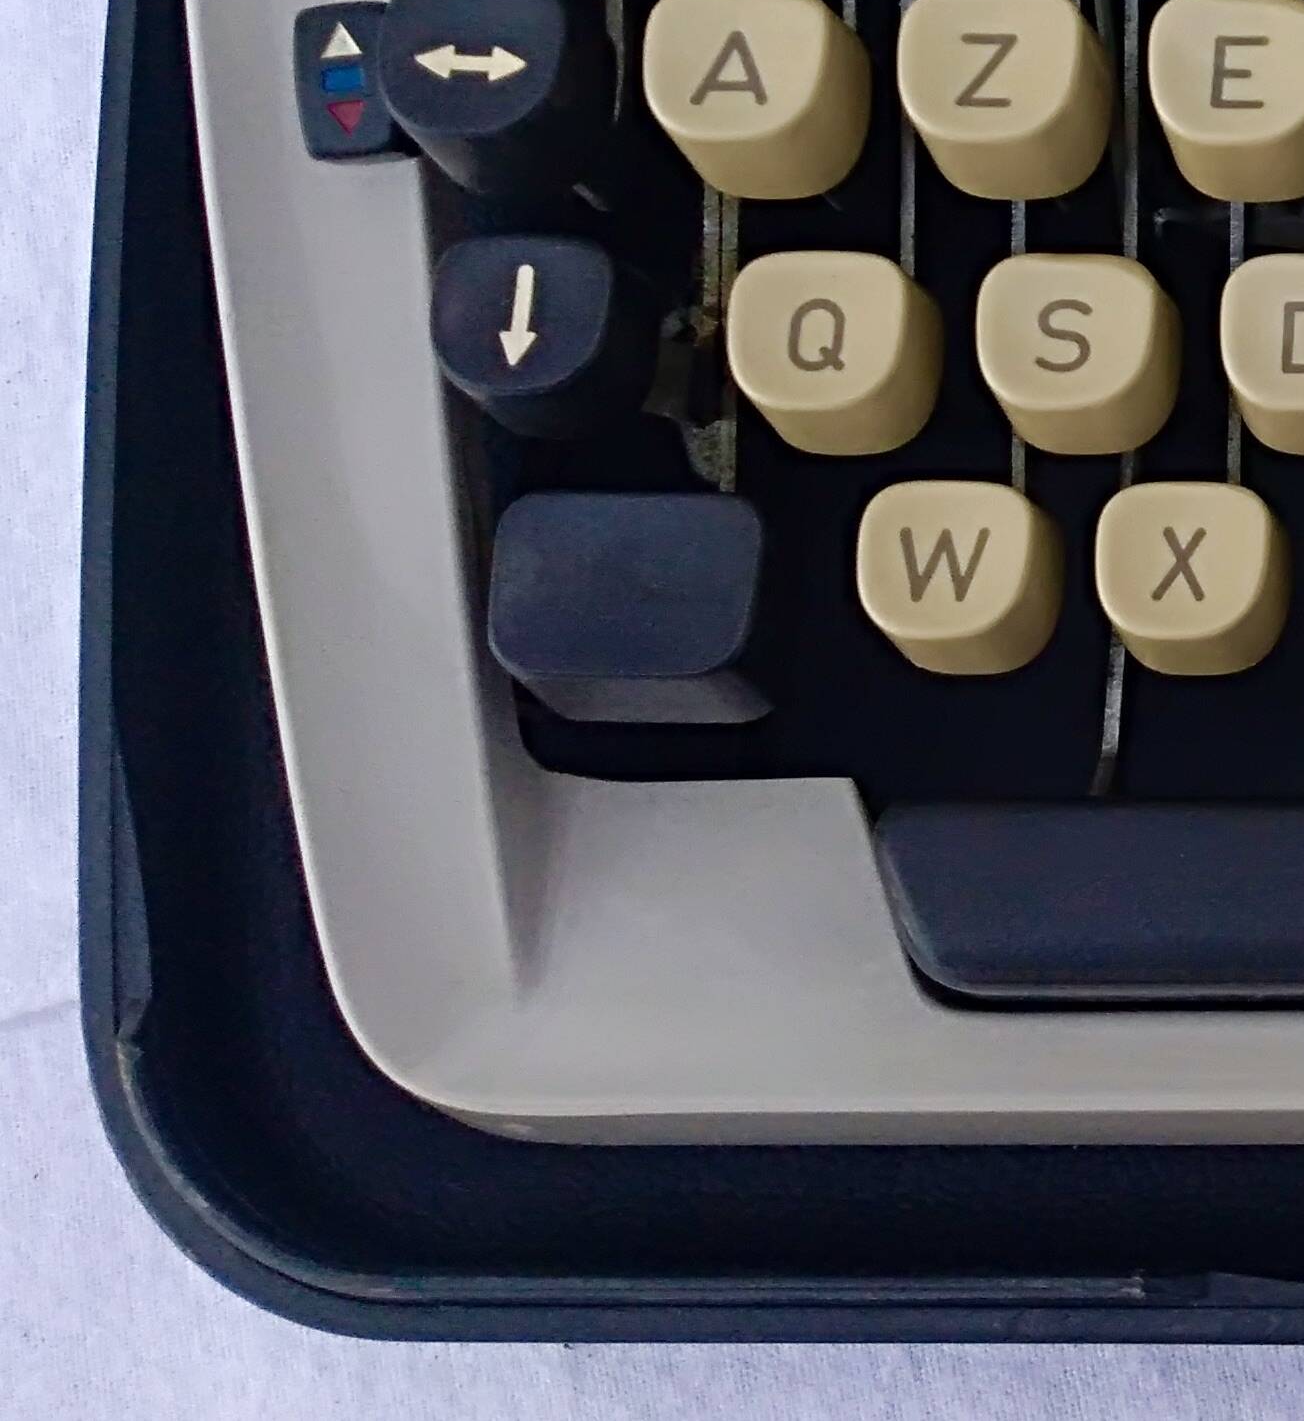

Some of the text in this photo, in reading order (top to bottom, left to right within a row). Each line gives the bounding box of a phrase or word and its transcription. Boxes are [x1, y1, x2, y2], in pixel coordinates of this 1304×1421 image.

[689, 30, 768, 106] A
[954, 32, 1019, 109] Z
[1209, 35, 1270, 110] E
[787, 298, 846, 372] Q
[1034, 298, 1093, 374] S
[899, 526, 991, 603] W
[1150, 526, 1208, 602] X
